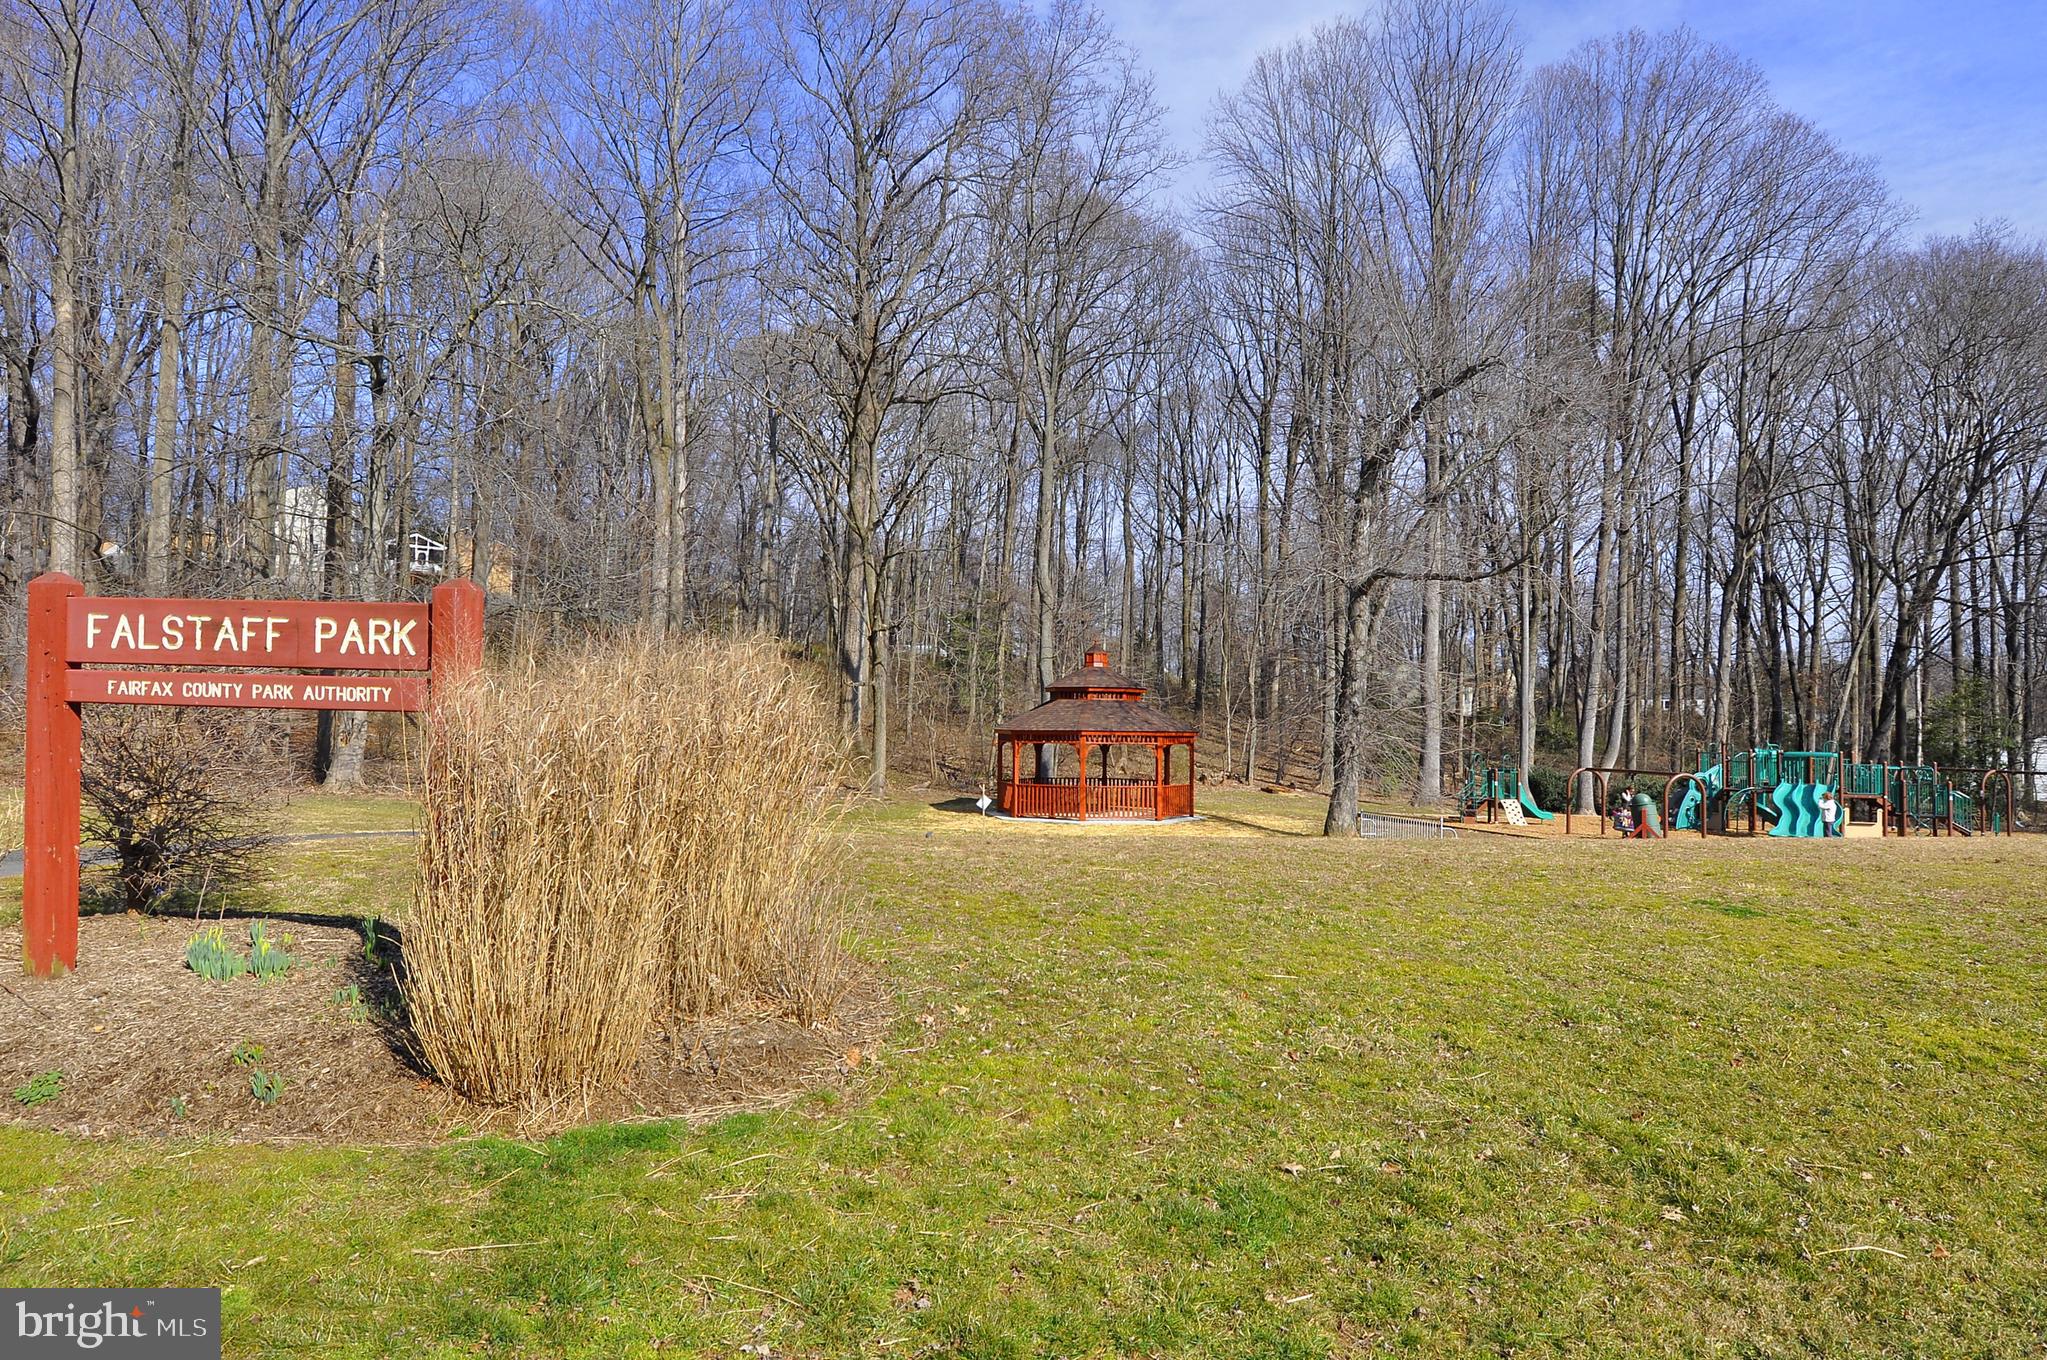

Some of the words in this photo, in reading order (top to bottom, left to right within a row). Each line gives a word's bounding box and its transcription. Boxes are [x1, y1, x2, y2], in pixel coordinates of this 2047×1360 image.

[86, 613, 290, 653] FALSTAFF
[314, 616, 417, 656] PARK
[107, 679, 174, 697] FAIRFAX
[182, 681, 242, 700] COUNTY
[251, 683, 294, 700] PARK
[303, 684, 393, 703] AUTHORITY
